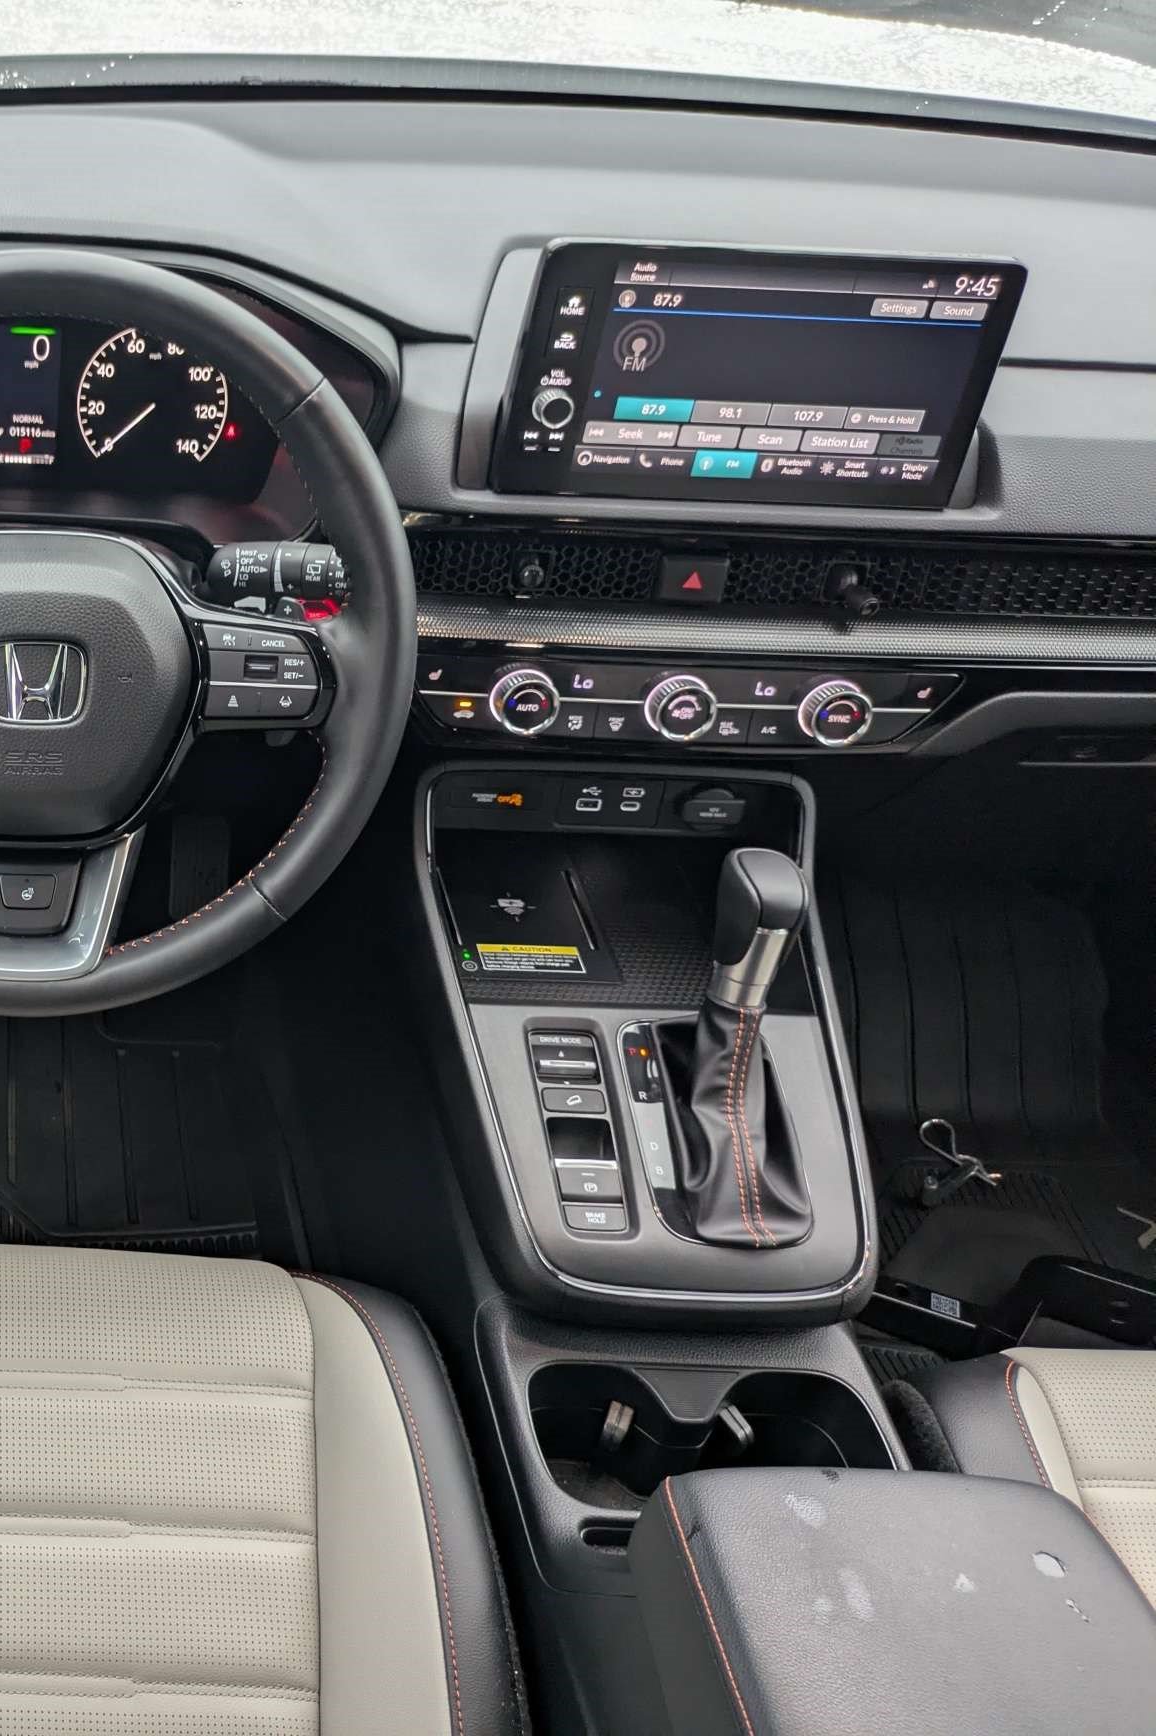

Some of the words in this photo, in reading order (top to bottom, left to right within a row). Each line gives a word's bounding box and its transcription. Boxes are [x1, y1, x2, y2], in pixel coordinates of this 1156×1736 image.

[634, 262, 658, 272] Audio
[630, 272, 656, 282] Source
[954, 276, 999, 296] 9:45
[652, 293, 683, 307] 87.9
[560, 306, 585, 316] HOME
[880, 303, 917, 314] Settings
[944, 306, 974, 316] Sound
[33, 335, 50, 361] 0
[127, 339, 145, 354] 60
[554, 340, 576, 350] BACK
[622, 357, 646, 371] FM
[96, 363, 115, 378] 40
[188, 367, 211, 382] 100
[550, 369, 565, 378] VOL
[548, 377, 572, 386] AUDIO
[87, 400, 105, 415] 20
[194, 405, 217, 420] 120
[641, 404, 666, 415] 87.9
[718, 407, 742, 418] 98.1
[12, 414, 44, 424] NORMAL
[794, 410, 824, 422] 107.9
[867, 414, 887, 423] Press
[887, 416, 895, 424] &
[896, 416, 916, 425] Hold
[617, 428, 643, 440] Seek
[697, 431, 722, 443] Tune
[757, 434, 783, 446] Scan
[811, 436, 848, 448] Station
[850, 437, 869, 449] List
[176, 439, 199, 453] 140
[593, 455, 630, 466] Navigation
[660, 457, 684, 467] Phone
[725, 459, 741, 469] FM
[777, 457, 812, 467] Bluetooth
[844, 459, 865, 469] Smart
[781, 466, 803, 475] Audio
[835, 468, 868, 478] Shortcuts
[902, 463, 928, 473] Display
[901, 471, 923, 480] Mode
[240, 557, 254, 565] OFF
[240, 566, 259, 574] AUTO
[261, 639, 285, 648] CANCEL
[572, 673, 594, 689] Lo
[754, 681, 777, 696] Lo
[515, 703, 539, 712] AUTO
[827, 714, 851, 723] SYNC
[760, 726, 777, 734] A/C
[4, 752, 63, 763] SRS
[539, 1036, 560, 1044] DRIVE
[561, 1037, 581, 1045] MODE
[638, 1090, 647, 1100] R
[649, 1141, 659, 1151] D
[585, 1211, 606, 1219] BRAKE
